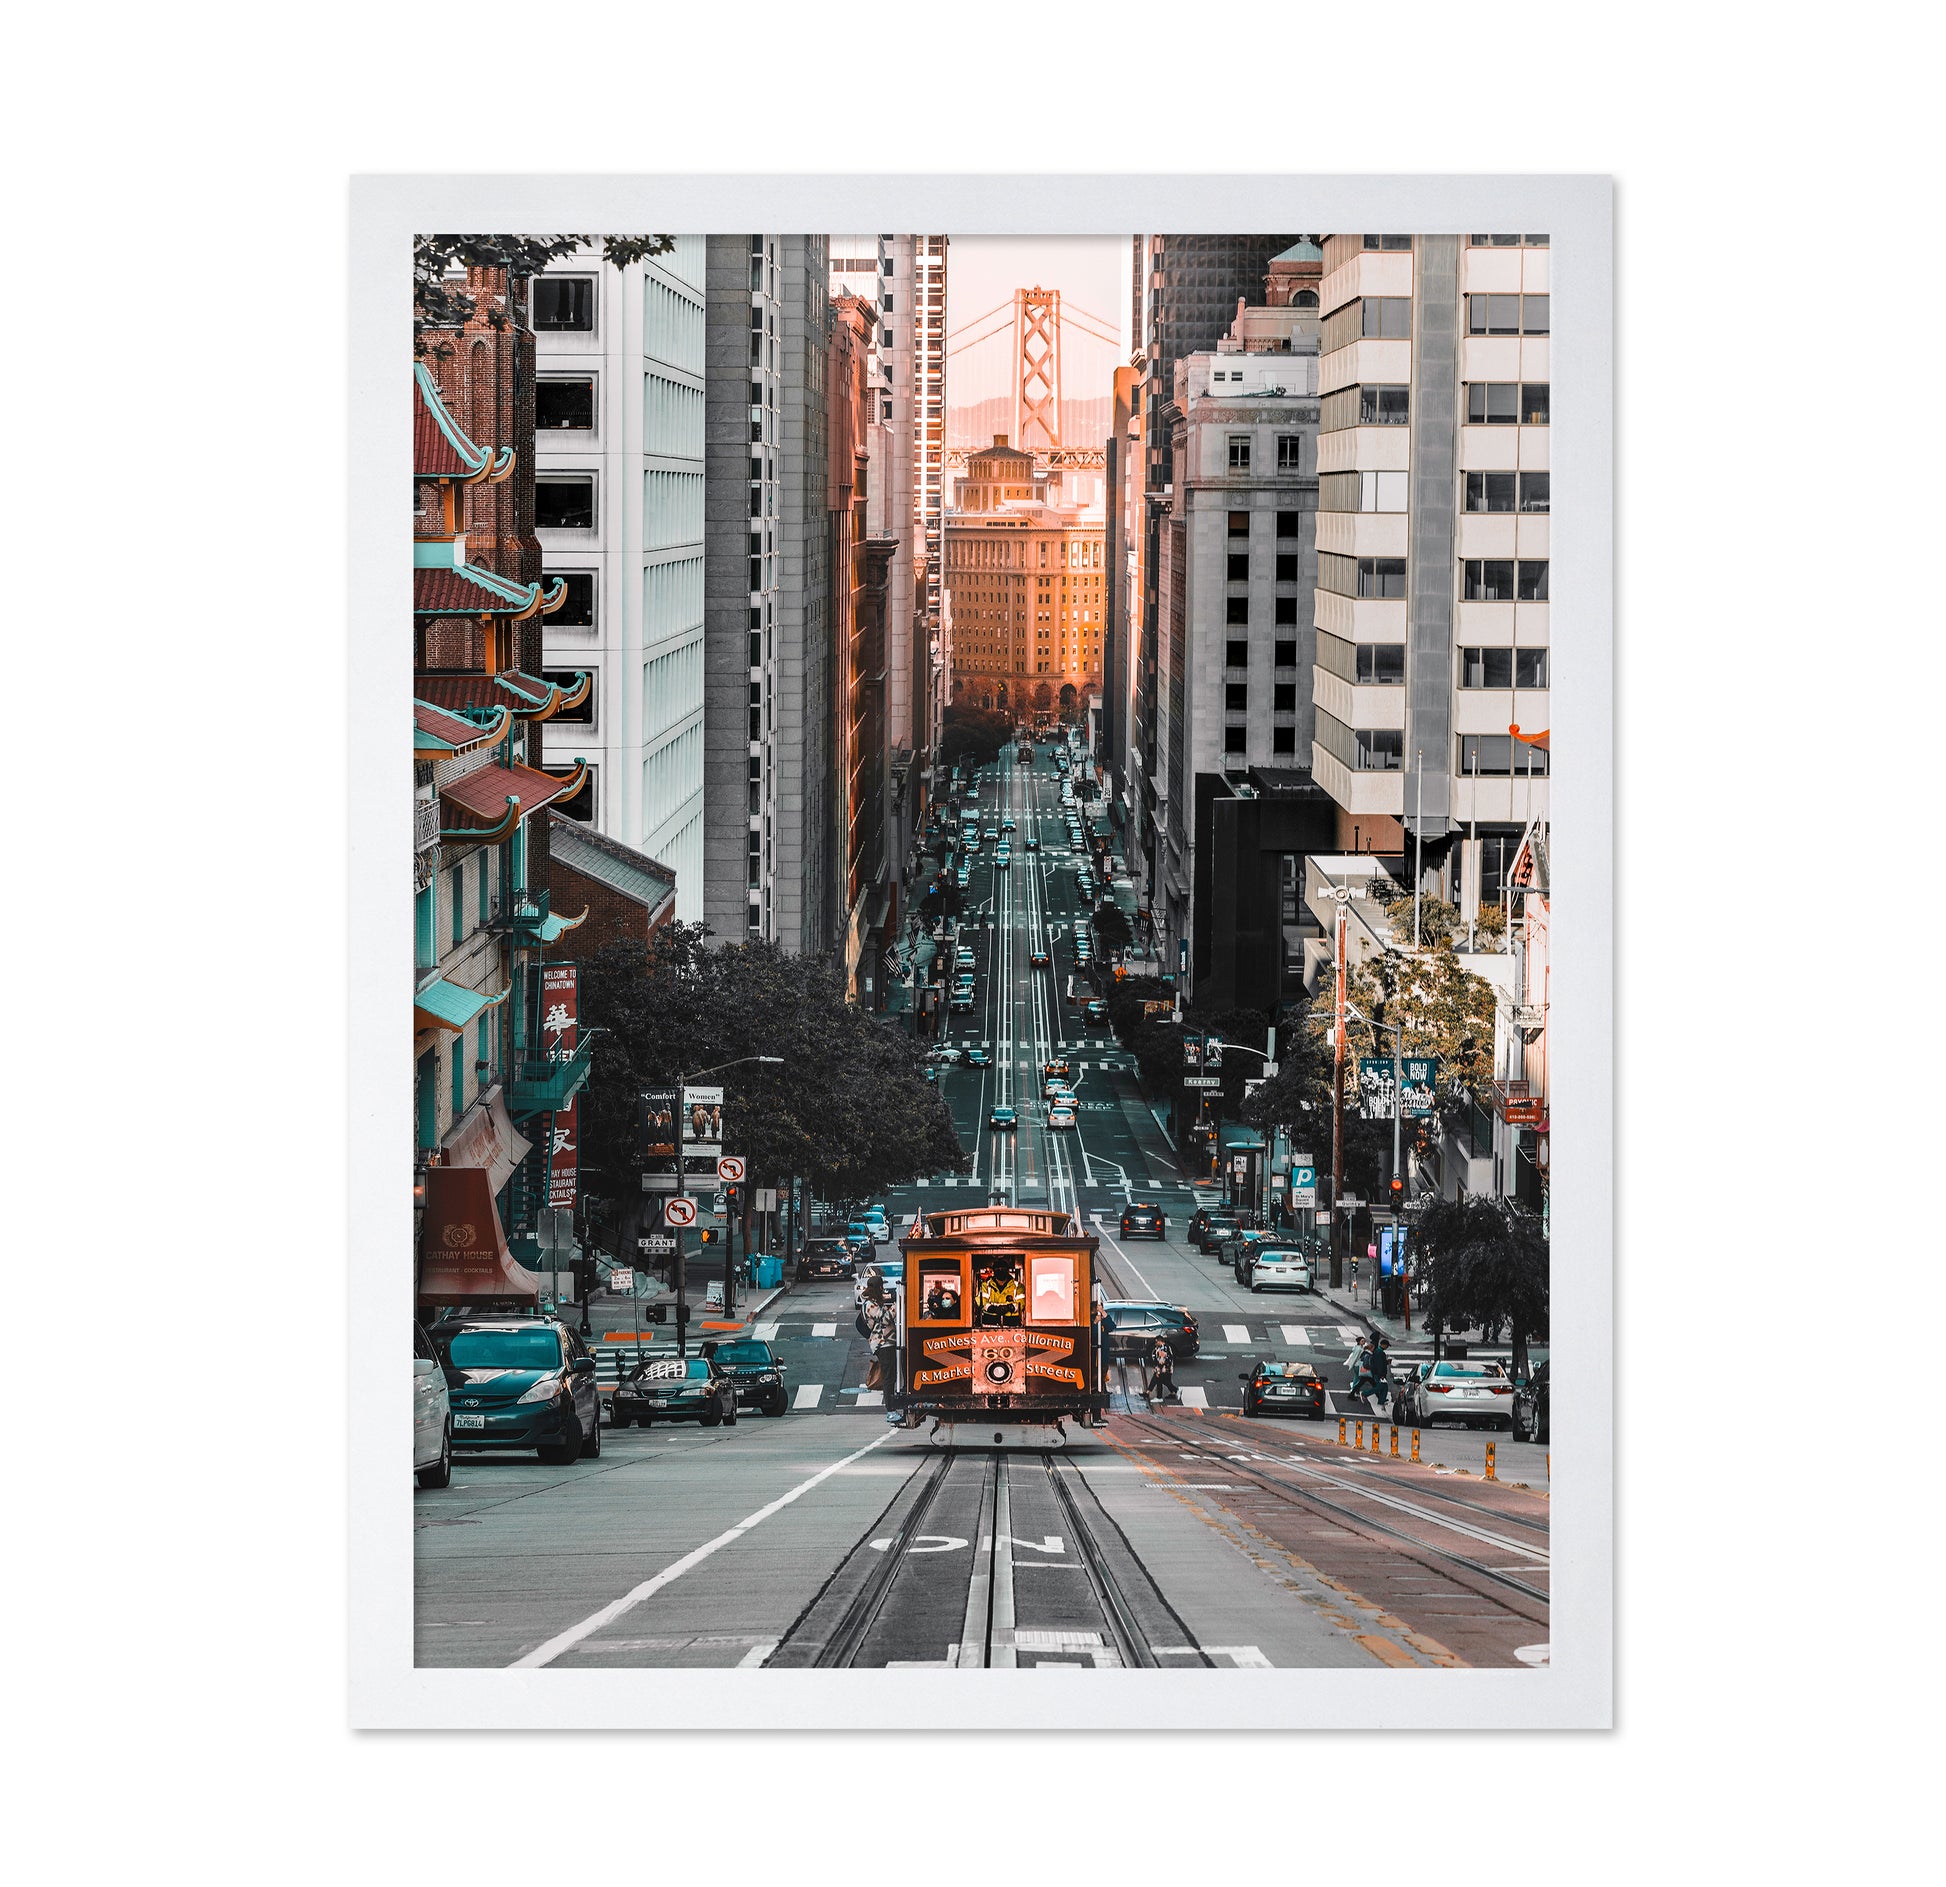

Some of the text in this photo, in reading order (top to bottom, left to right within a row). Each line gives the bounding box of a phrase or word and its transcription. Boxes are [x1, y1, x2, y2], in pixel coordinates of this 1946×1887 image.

[543, 969, 577, 980] WELCOME TO
[544, 980, 575, 990] CHINATOWN
[1410, 1063, 1428, 1071] BOLD
[1410, 1071, 1428, 1080] NOW
[1369, 1096, 1386, 1104] BOLD
[561, 1168, 577, 1177] HOUSE
[547, 1177, 576, 1189] STAURANT
[547, 1189, 570, 1200] CKTAILS
[425, 1251, 494, 1260] CATHAY HOUSE
[926, 1339, 947, 1351] Van
[948, 1335, 977, 1347] Ness
[1013, 1333, 1072, 1349] California
[983, 1348, 1014, 1360] 60
[921, 1363, 1076, 1382] & Market Streets
